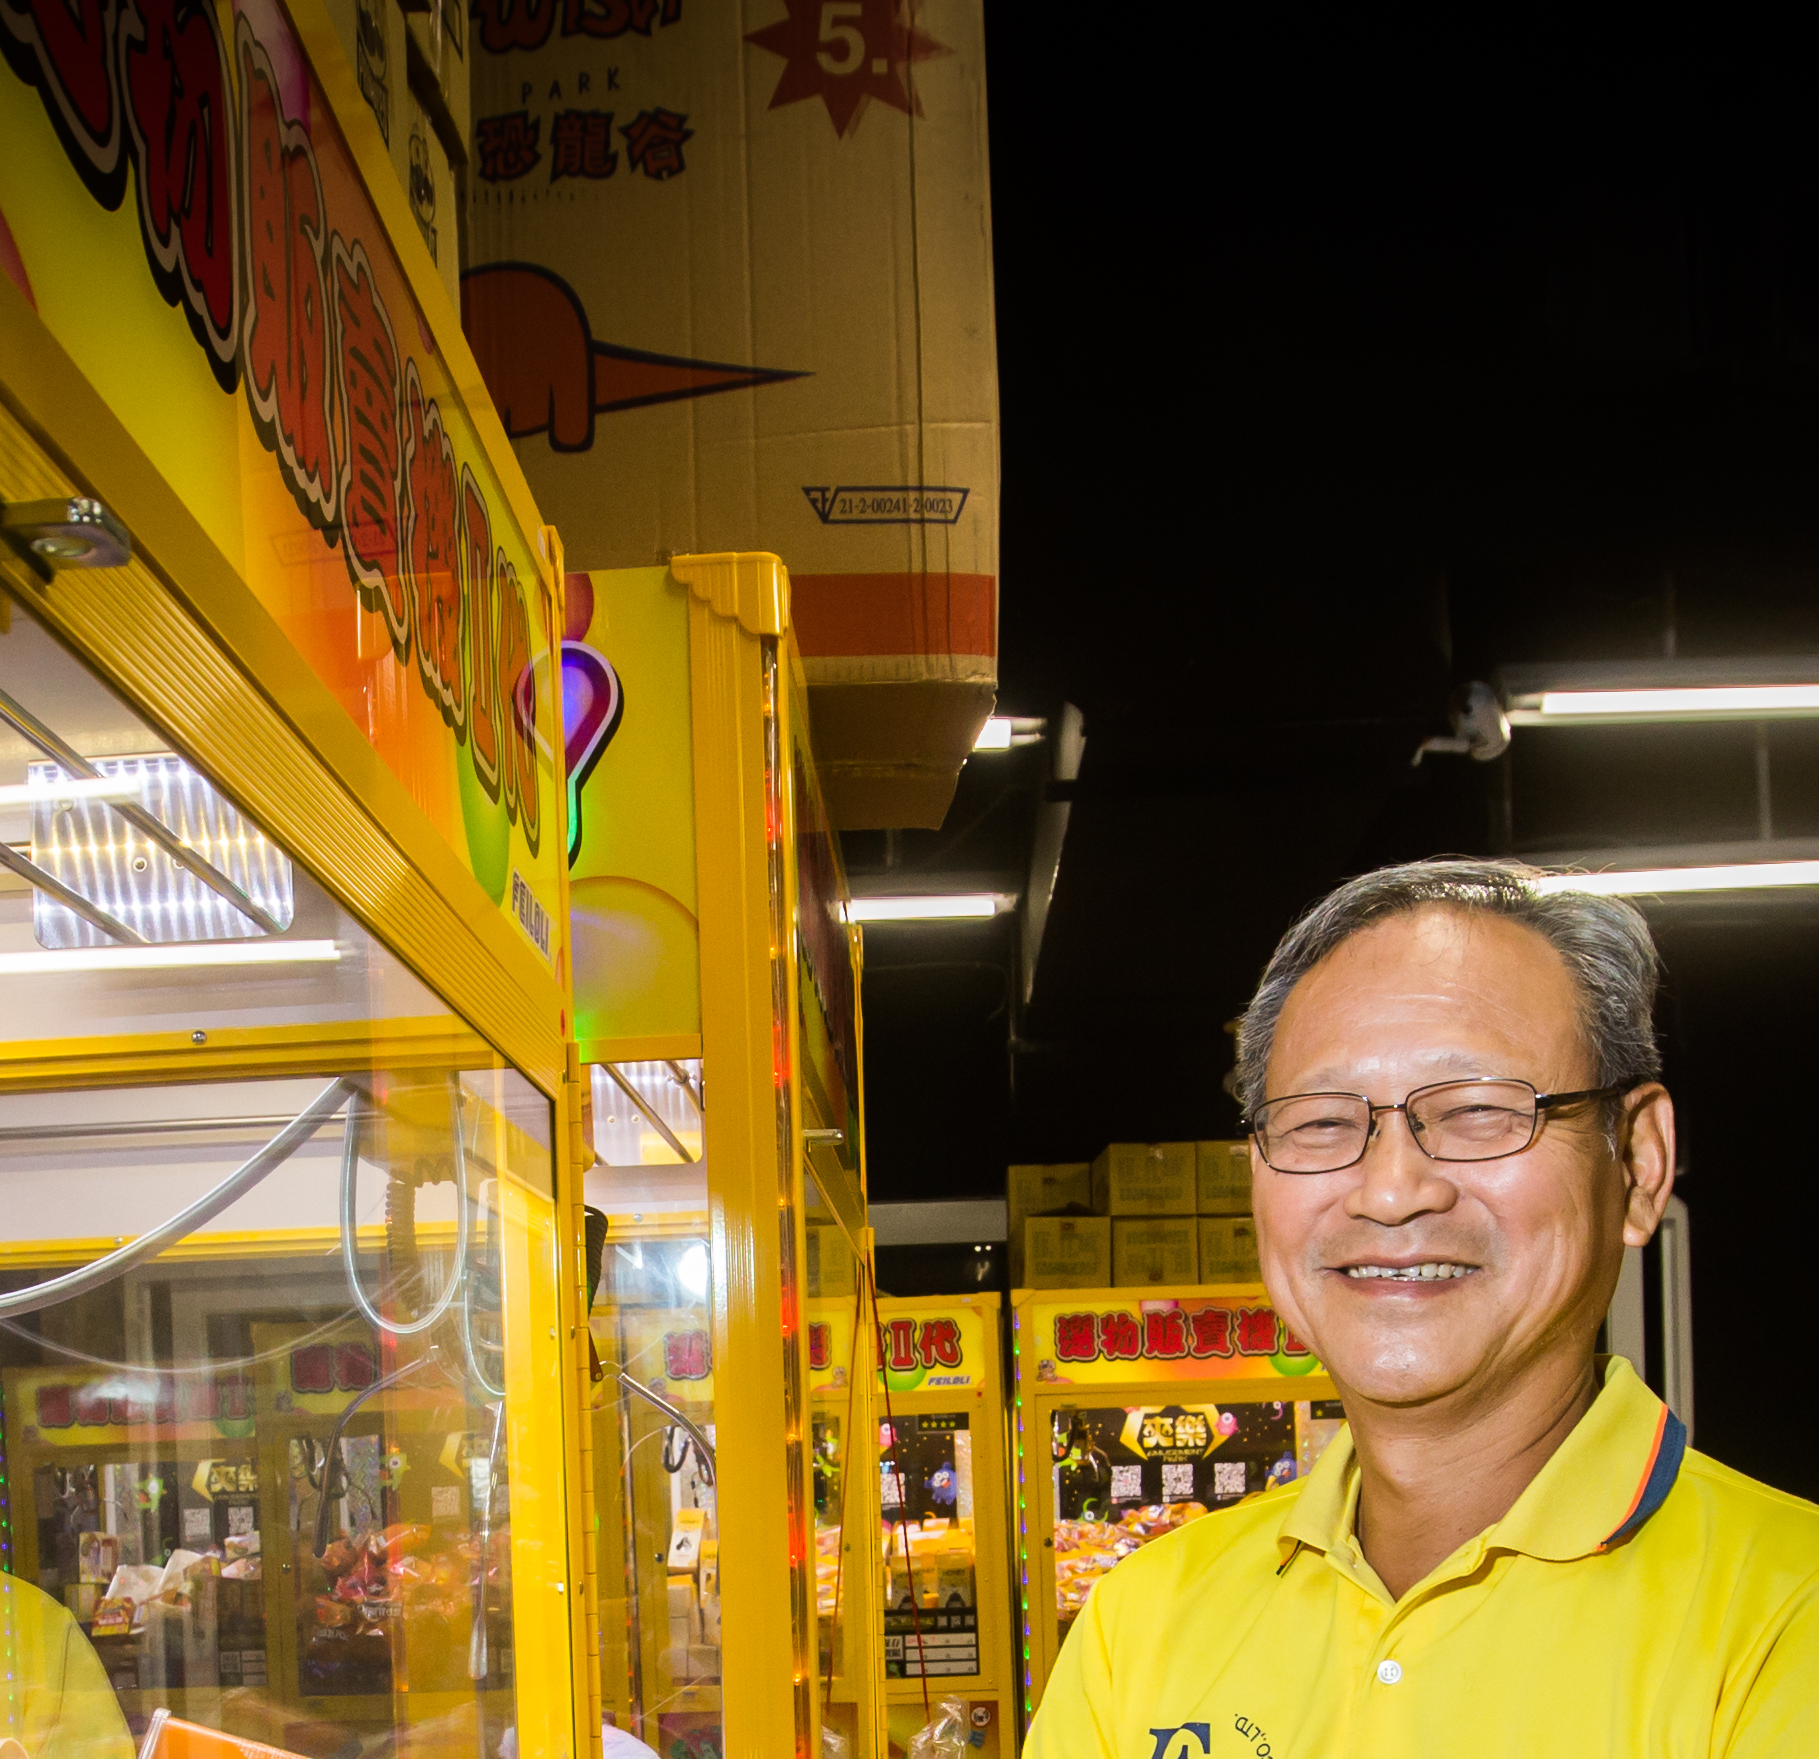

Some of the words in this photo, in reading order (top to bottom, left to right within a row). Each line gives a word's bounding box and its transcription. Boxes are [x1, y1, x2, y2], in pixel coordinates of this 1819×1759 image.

[521, 66, 621, 104] PARK
[476, 107, 696, 184] 恐龍谷
